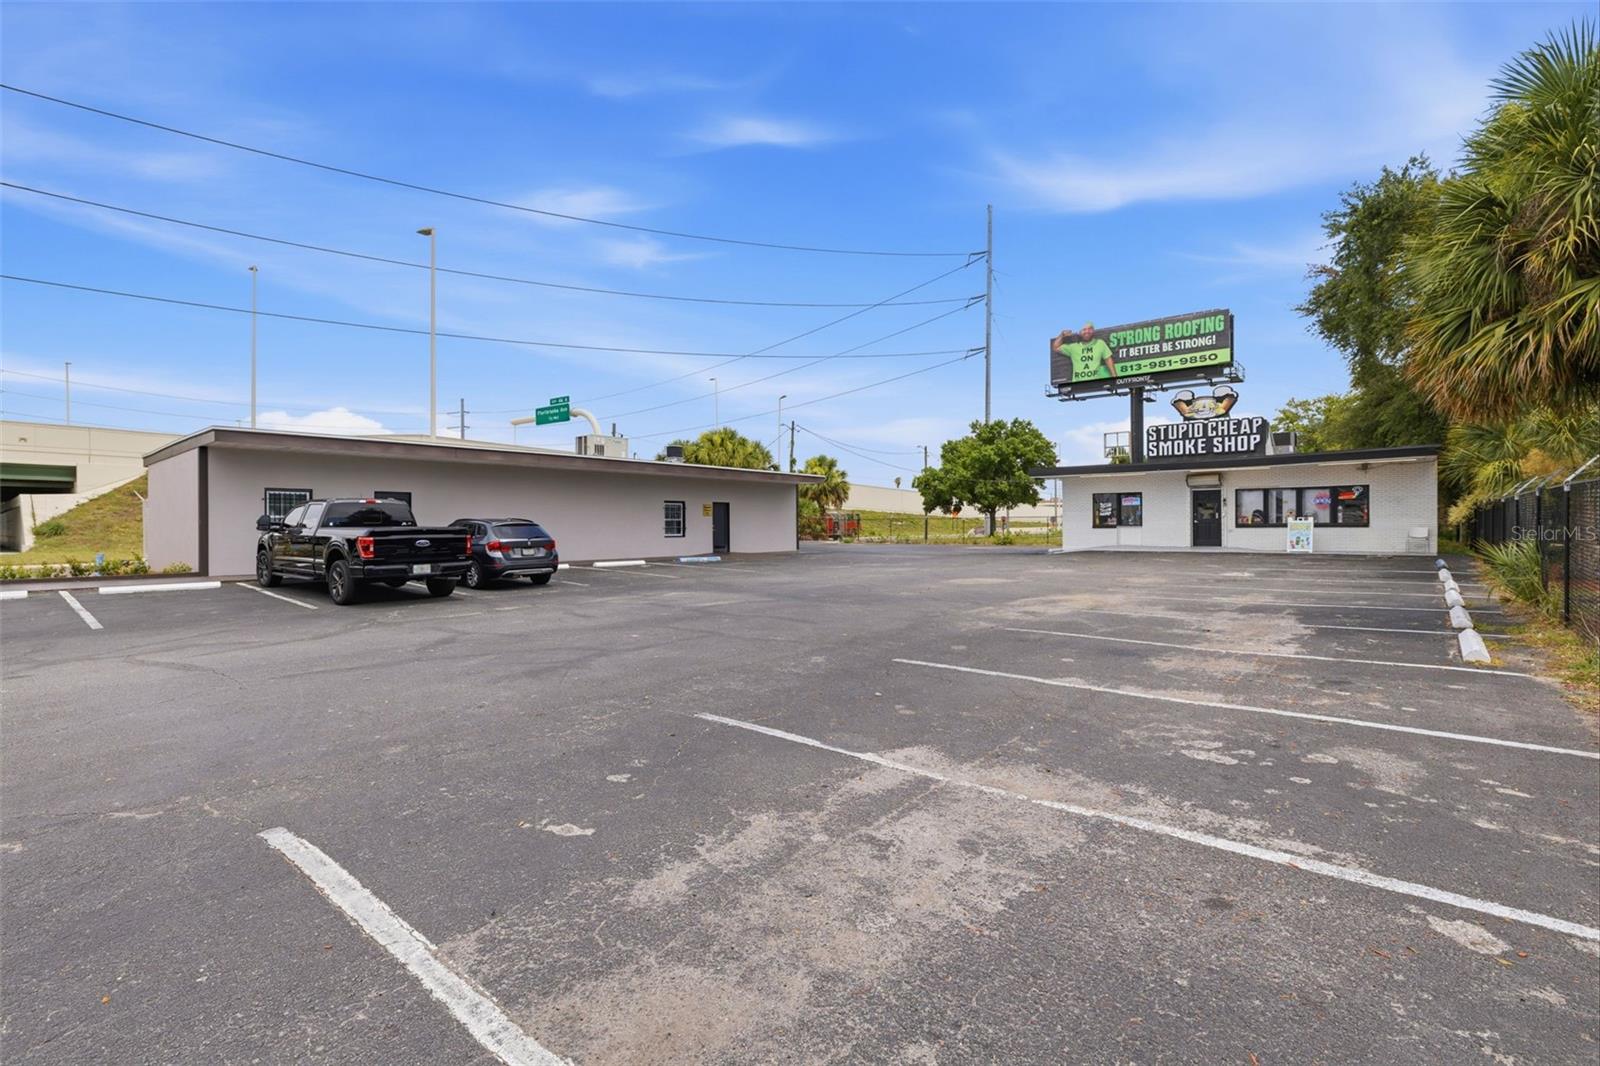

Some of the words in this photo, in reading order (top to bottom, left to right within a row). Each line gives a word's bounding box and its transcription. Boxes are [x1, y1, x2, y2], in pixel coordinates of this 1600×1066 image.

[1109, 326, 1160, 348] STRONG
[1165, 315, 1225, 340] ROOFING
[1119, 347, 1128, 358] IT
[1129, 343, 1160, 358] BETTER
[1162, 341, 1173, 352] BE
[1175, 335, 1217, 350] STRONG!
[1074, 370, 1098, 379] ROOF
[1120, 353, 1218, 373] 813-981-9850
[1148, 423, 1203, 441] STUPID
[1208, 418, 1263, 437] CHEAP
[1148, 439, 1207, 457] SMOKE
[1213, 434, 1261, 453] SHOP
